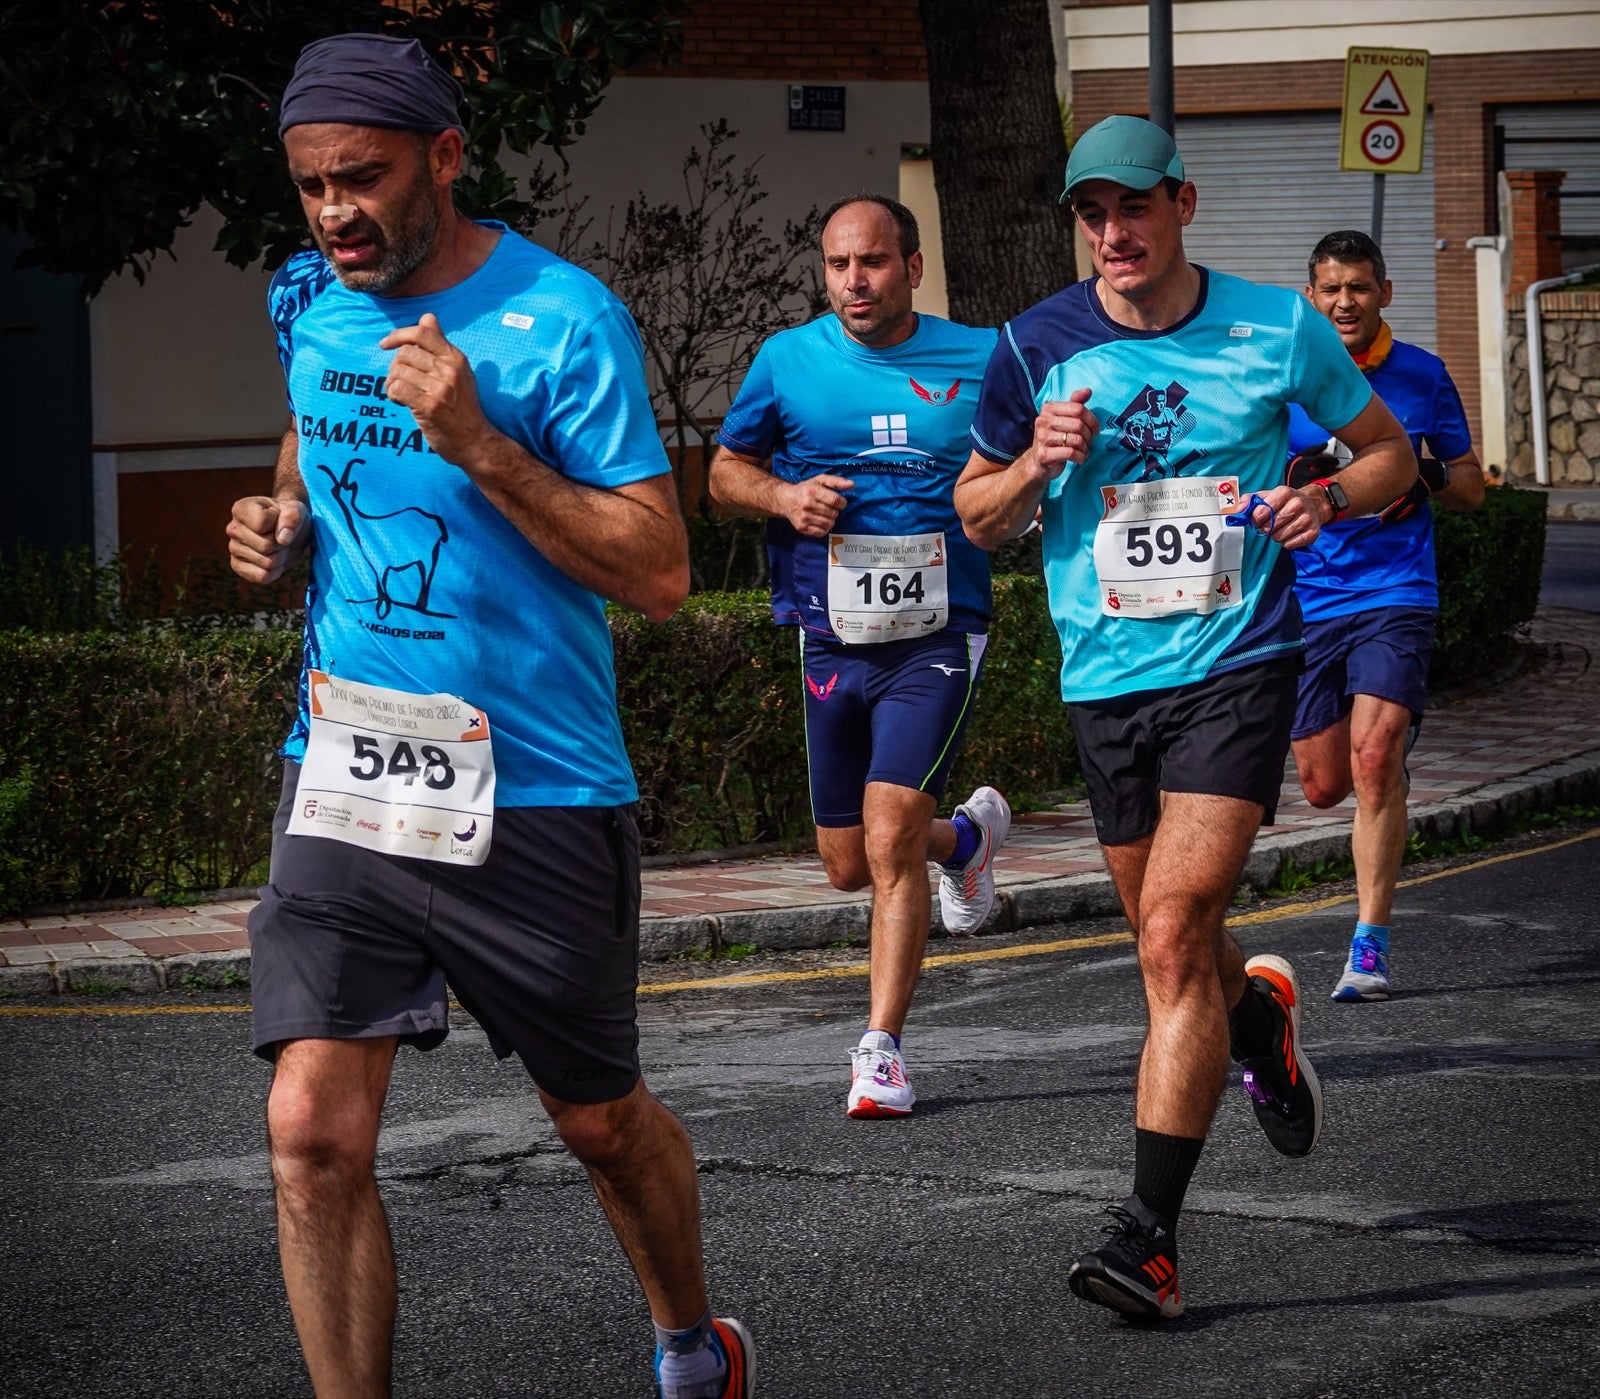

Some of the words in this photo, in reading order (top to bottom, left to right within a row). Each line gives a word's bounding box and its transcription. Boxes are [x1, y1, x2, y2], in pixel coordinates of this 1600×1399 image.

[808, 90, 839, 102] CALLE
[1370, 133, 1396, 150] 20
[320, 369, 388, 400] BOSQ
[302, 415, 436, 456] CAMARA
[1147, 488, 1169, 502] PREMIO
[1182, 486, 1203, 498] FONDO
[1143, 502, 1171, 514] UNIVERSO
[1171, 501, 1189, 511] LORCA
[858, 543, 873, 554] GRAN
[874, 544, 892, 555] PREMIO
[901, 543, 918, 554] FONDO
[918, 543, 931, 553] 2022
[1126, 522, 1213, 568] 593
[856, 571, 925, 606] 164
[412, 630, 446, 640] 2021
[368, 696, 396, 714] PREMIO
[396, 703, 407, 716] DE
[408, 703, 434, 720] FONDO
[435, 703, 461, 720] 2022
[367, 710, 397, 728] UNIVERSO
[396, 716, 419, 730] LORCA
[349, 734, 456, 790] 548
[324, 812, 351, 822] Granada
